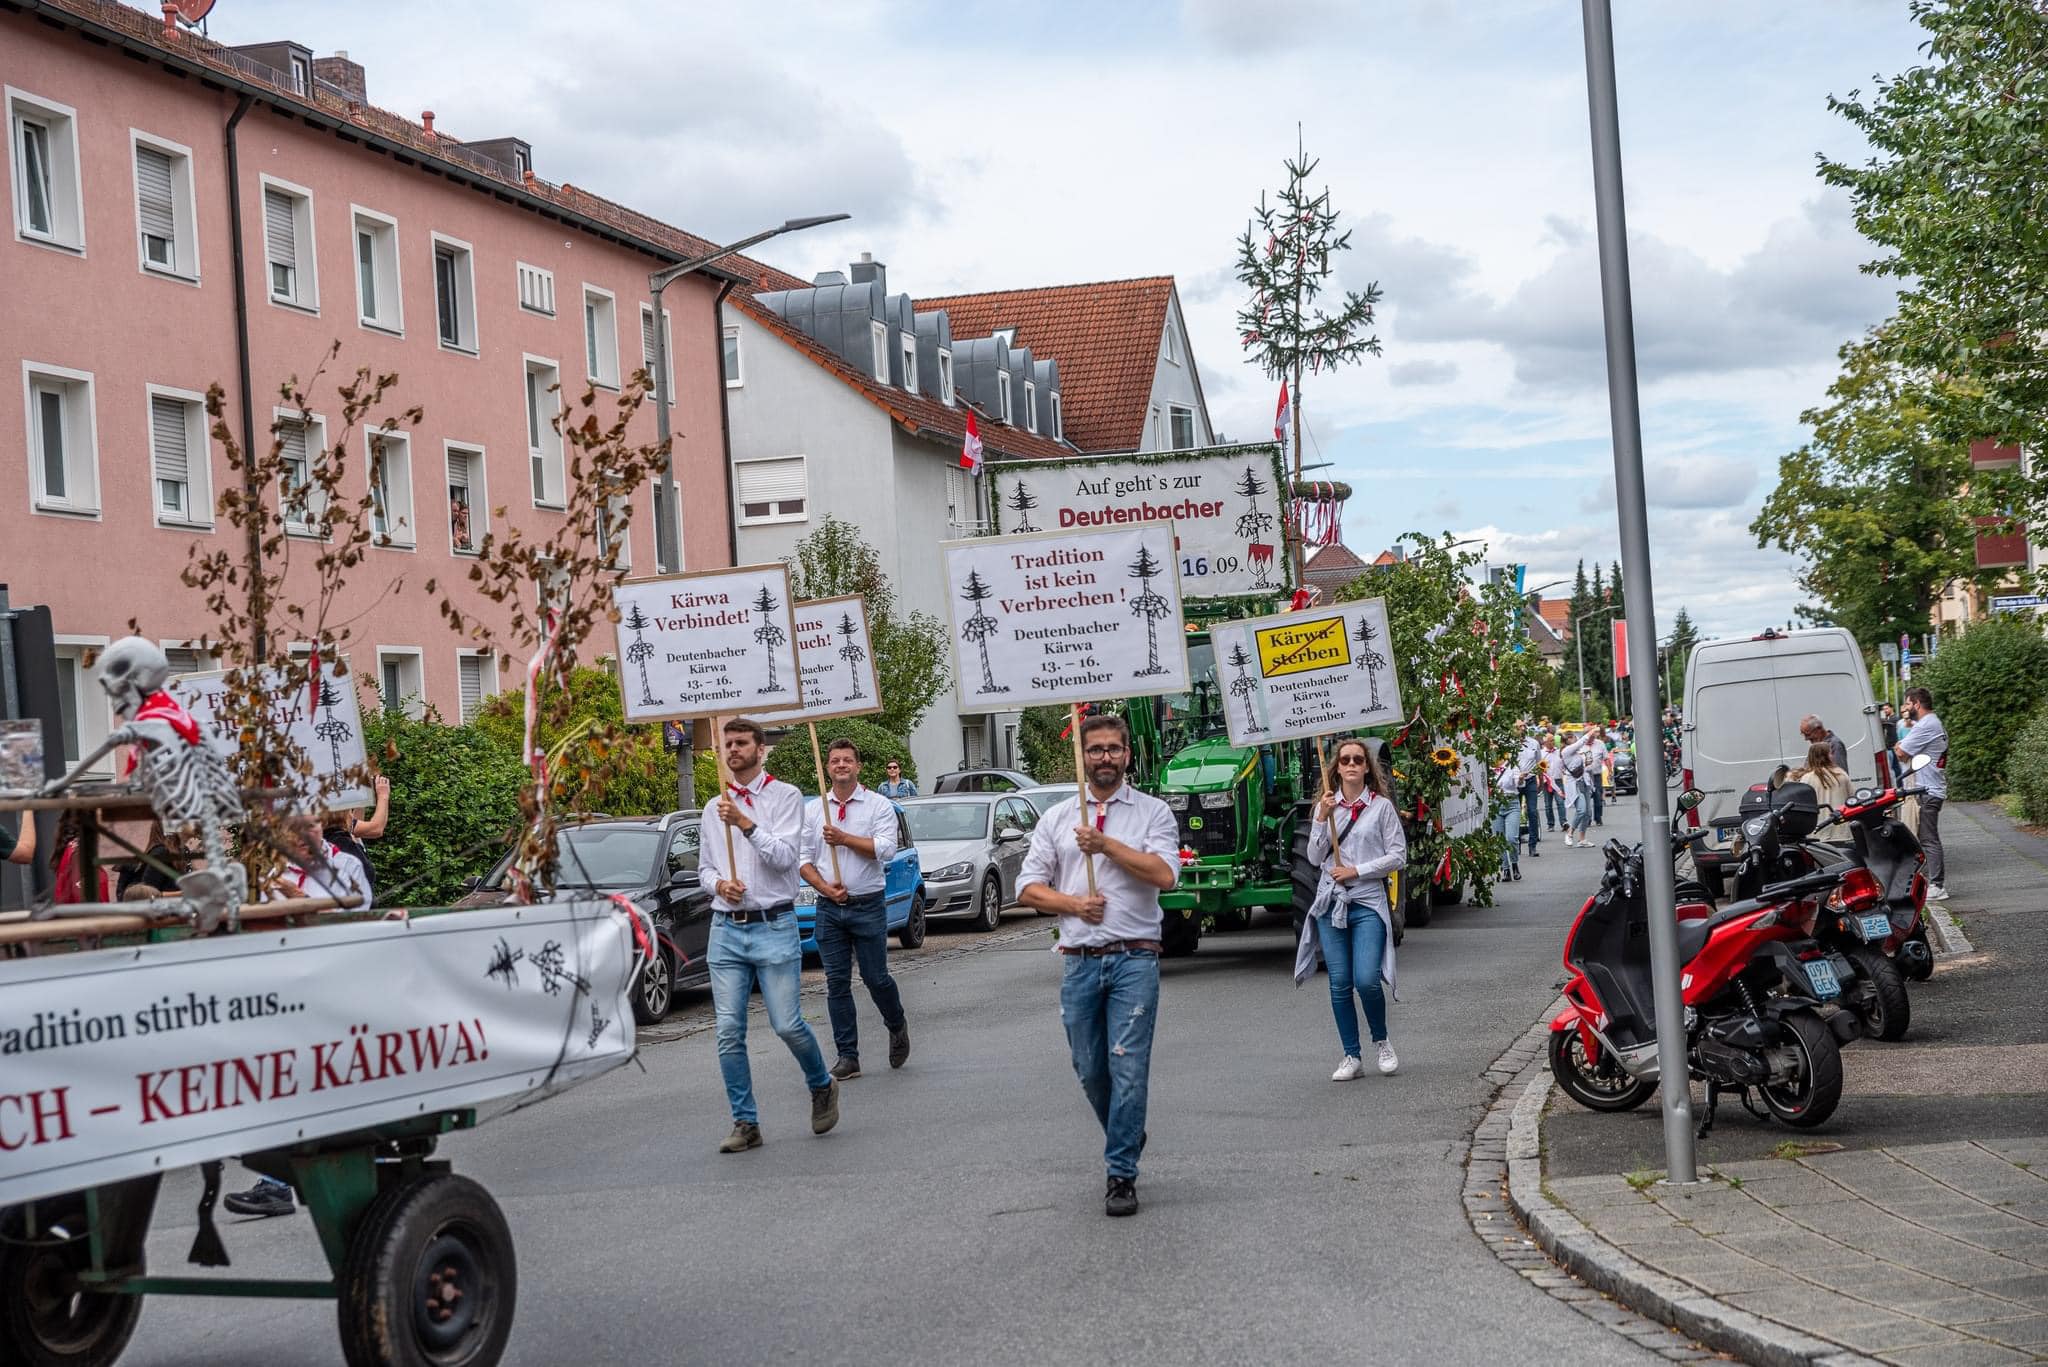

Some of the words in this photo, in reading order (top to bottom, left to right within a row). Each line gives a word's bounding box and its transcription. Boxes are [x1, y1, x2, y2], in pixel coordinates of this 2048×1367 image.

[1076, 477, 1109, 496] Auf
[1173, 474, 1202, 489] zur
[1059, 498, 1224, 528] Deutenbacher
[1011, 547, 1104, 570] Tradition
[1025, 575, 1048, 590] ist
[1054, 570, 1096, 588] kein
[671, 591, 730, 609] Kärwa
[1000, 590, 1115, 614] Verbrechen
[654, 608, 750, 632] Verbindet!
[796, 620, 823, 632] uns
[1014, 621, 1120, 641] Deutenbacher
[1270, 629, 1335, 648] Kärwa-
[798, 634, 832, 650] uch!
[1044, 640, 1093, 655] Kärwa
[667, 647, 747, 663] Deutenbacher
[1272, 647, 1340, 668] sterben
[689, 663, 727, 675] Kärwa
[800, 664, 834, 675] bacher
[1041, 661, 1061, 673] 13.
[1080, 656, 1100, 668] 16.
[687, 679, 704, 690] 13.
[716, 675, 732, 686] 16.
[800, 678, 818, 686] rwa
[1031, 671, 1113, 691] September
[1270, 673, 1349, 694] Deutenbacher
[680, 689, 742, 705] September
[810, 687, 824, 696] 16.
[1292, 690, 1330, 702] Kärwa
[1292, 705, 1307, 716] 13.
[1320, 701, 1336, 710] 16.
[1285, 711, 1346, 728] September
[1814, 977, 1837, 992] GEK
[0, 1003, 126, 1055] adition
[135, 992, 220, 1036] stirbt
[228, 991, 305, 1021] aus...
[136, 1049, 299, 1125] KEINE
[310, 1017, 489, 1092] KÄRWA!
